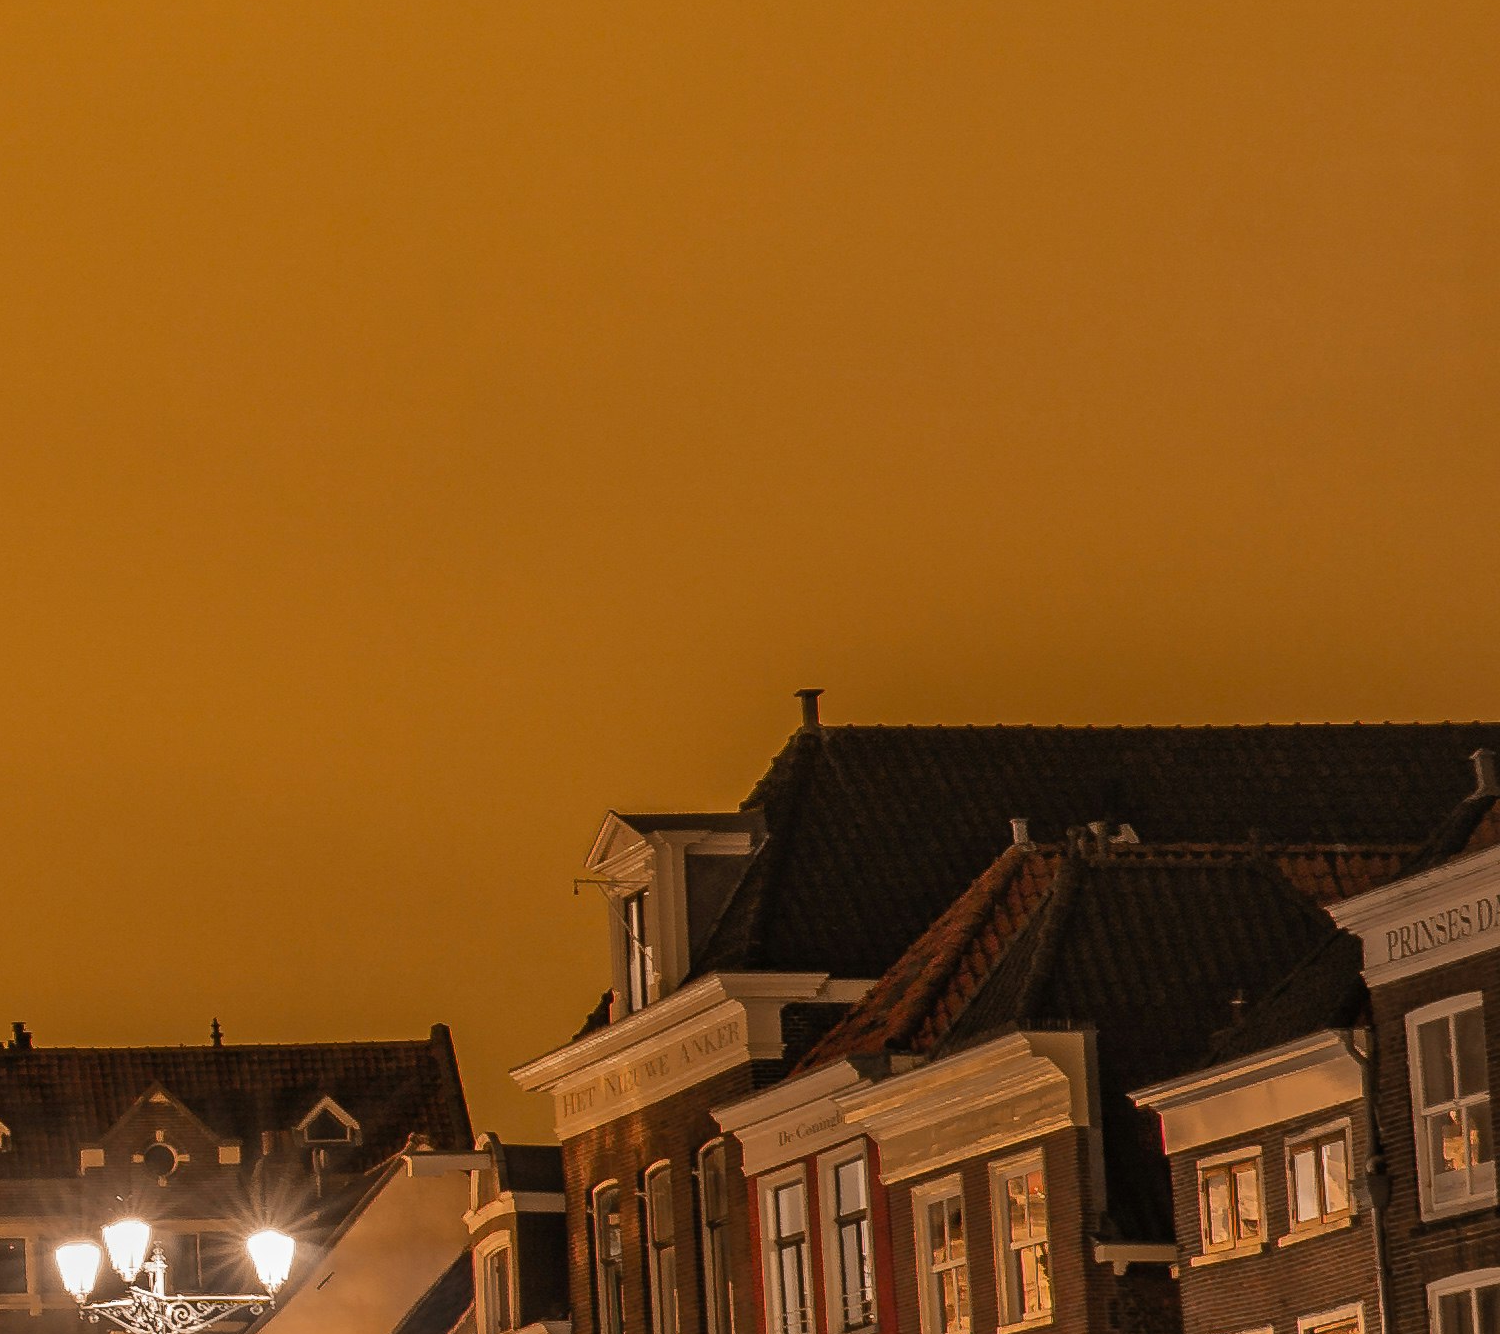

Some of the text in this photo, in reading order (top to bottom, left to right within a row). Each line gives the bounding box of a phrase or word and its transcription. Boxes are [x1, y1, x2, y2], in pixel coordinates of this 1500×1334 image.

[1386, 905, 1472, 962] PRINSES
[563, 1086, 595, 1118] HET
[680, 1021, 740, 1065] ANKER
